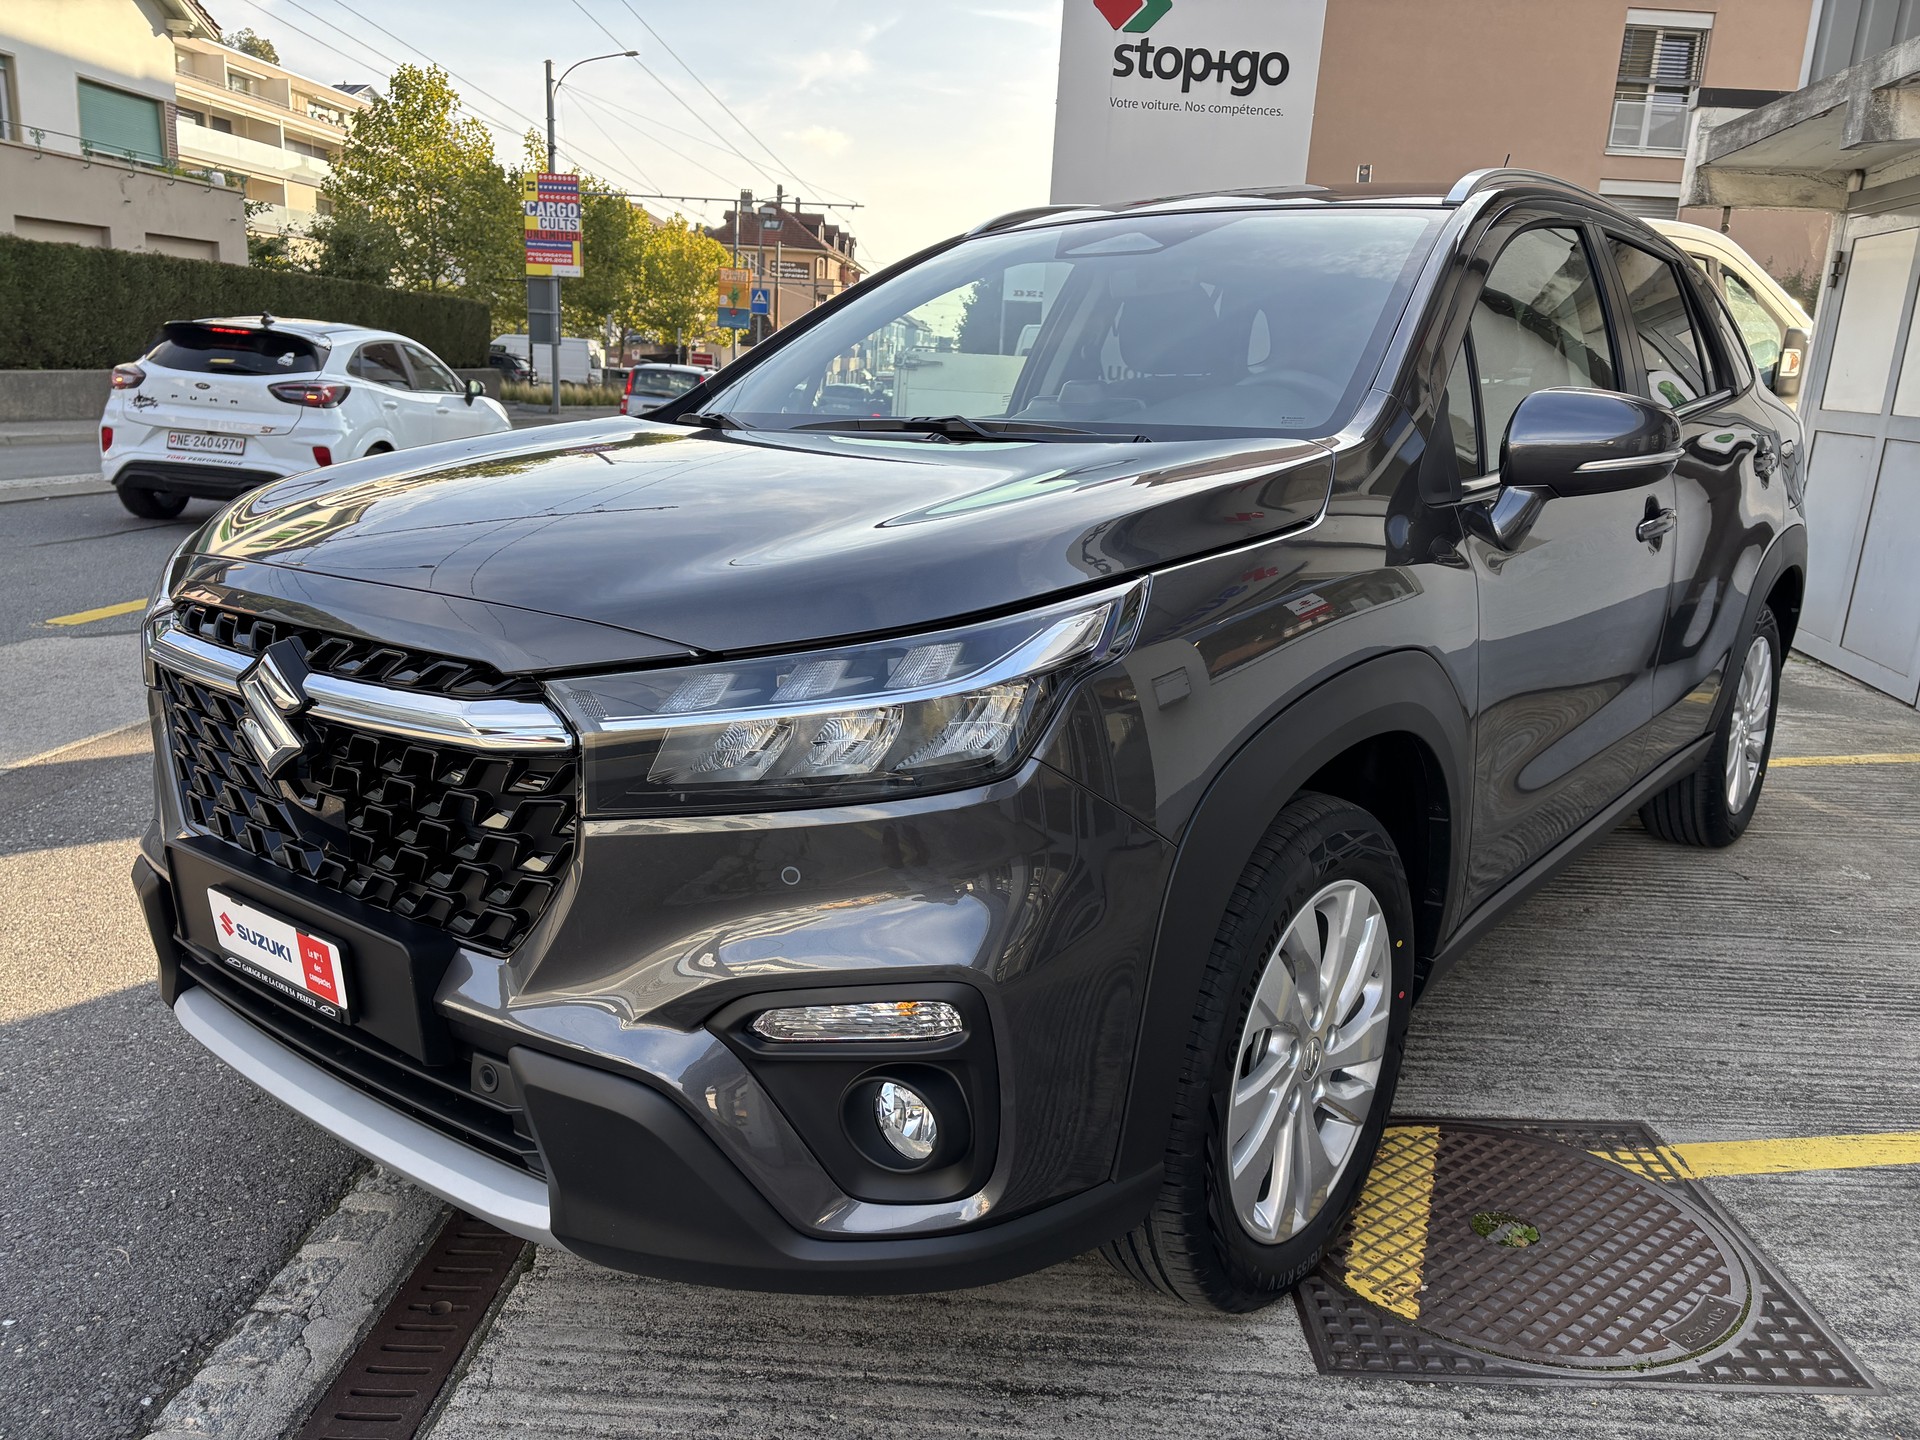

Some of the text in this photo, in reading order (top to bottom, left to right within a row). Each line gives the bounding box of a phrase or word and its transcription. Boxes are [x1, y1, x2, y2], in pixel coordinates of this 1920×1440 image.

[1113, 37, 1290, 97] stop+go
[1109, 97, 1284, 117] Votre voiture. Nos compétences.
[526, 201, 578, 218] CARGO
[540, 217, 578, 231] CULTS
[526, 230, 578, 241] UNLIMITED
[260, 426, 277, 434] ST
[187, 456, 244, 466] PERFORMANCE
[236, 923, 293, 963] SUZUKI
[313, 963, 322, 974] des
[242, 963, 316, 1008] GARAGE DE LA COUR SA PESEUX
